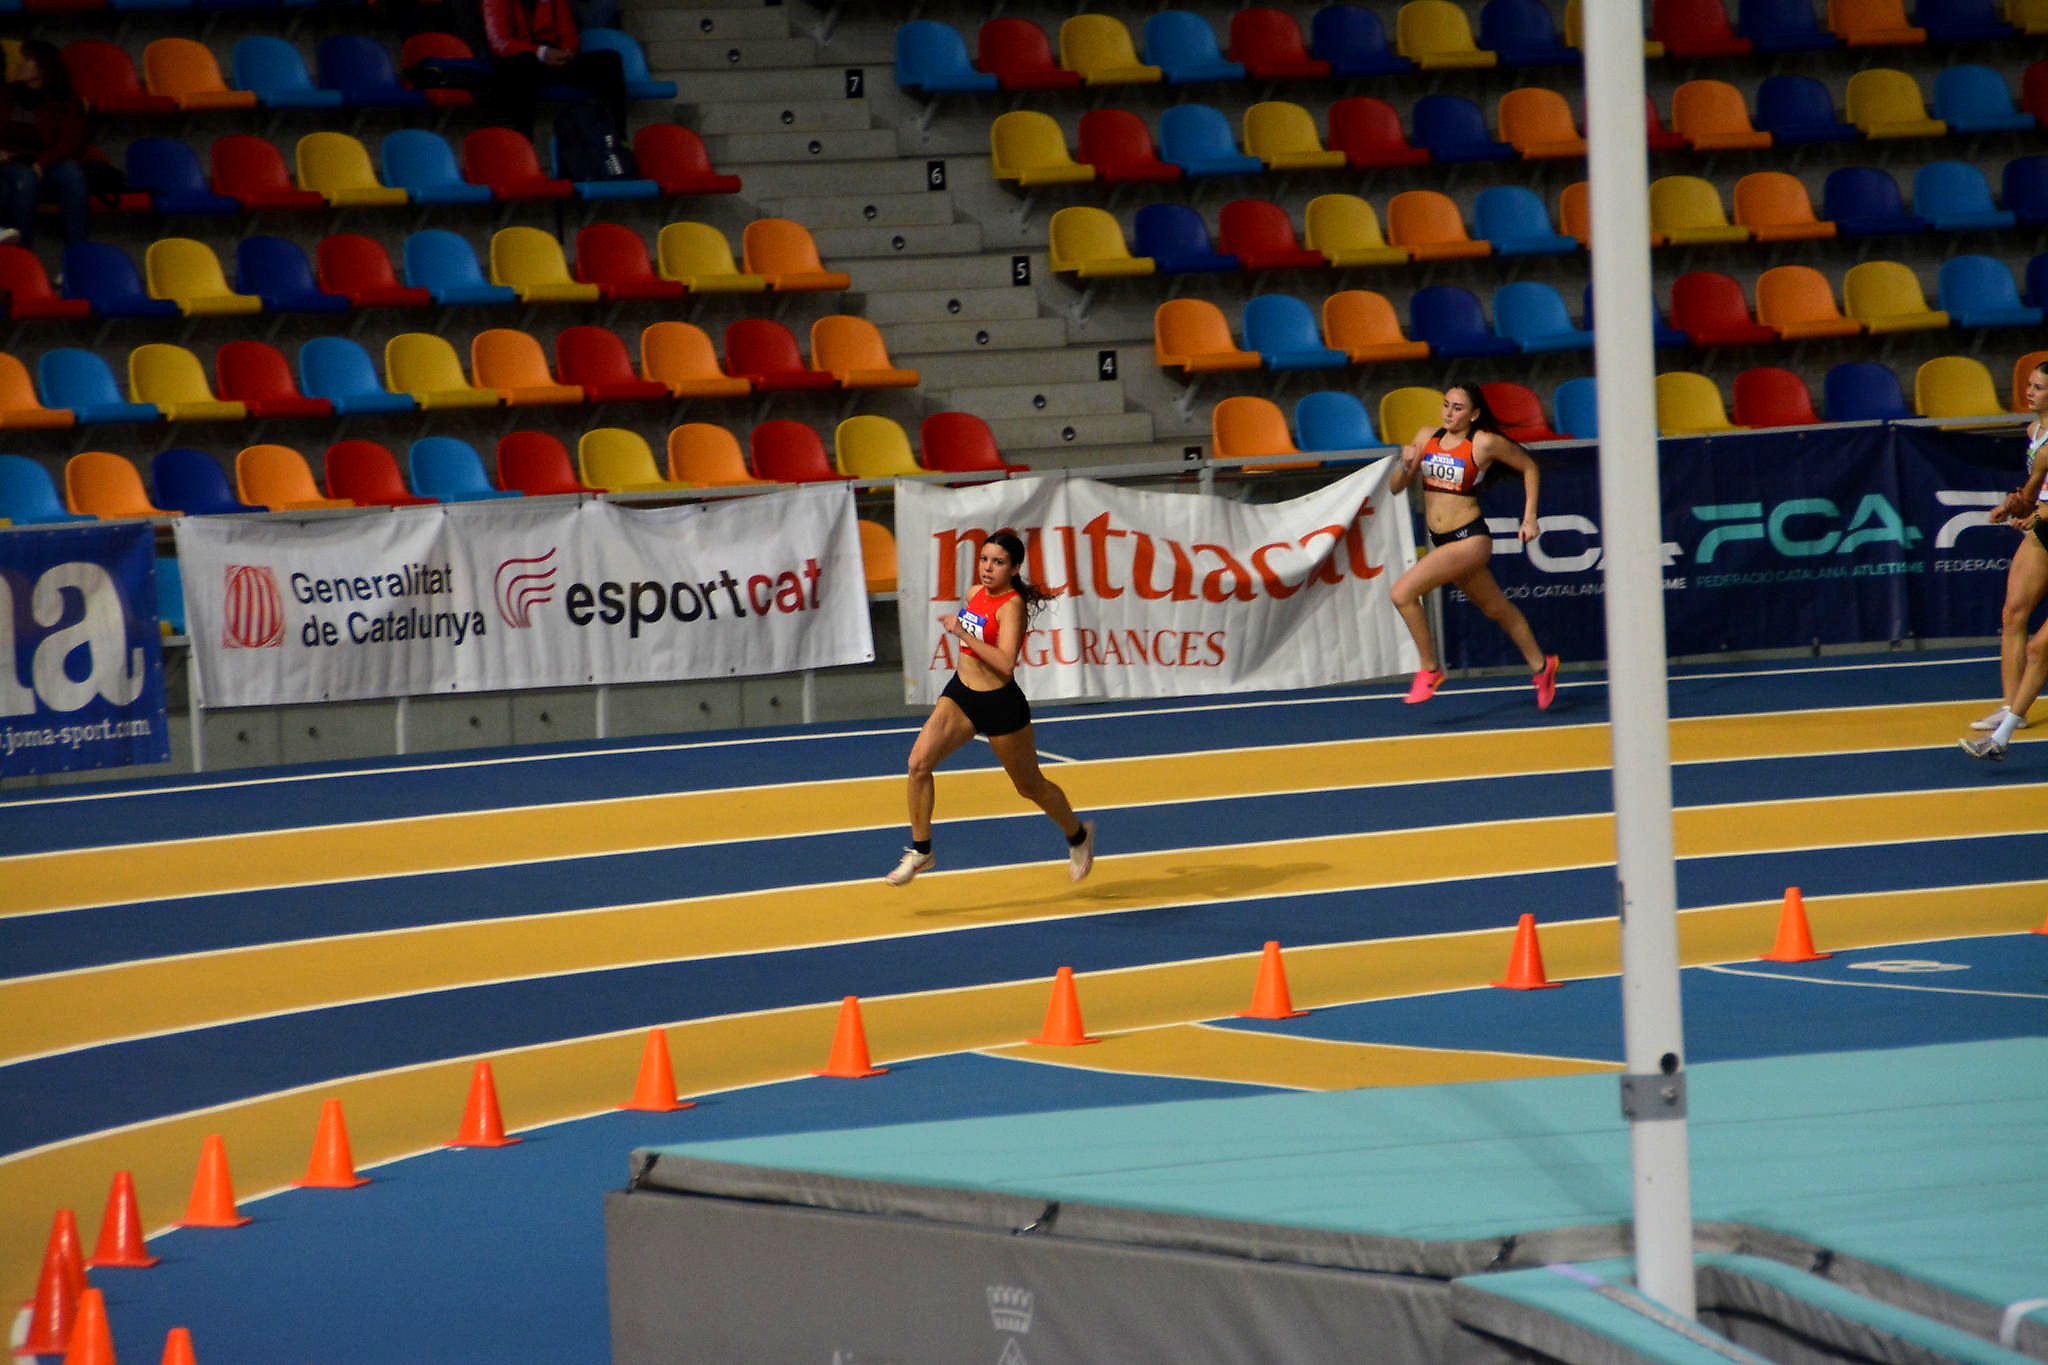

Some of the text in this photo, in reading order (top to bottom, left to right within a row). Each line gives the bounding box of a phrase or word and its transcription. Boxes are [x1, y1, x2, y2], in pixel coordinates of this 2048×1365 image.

[849, 76, 860, 93] 7
[931, 167, 943, 183] 6
[1016, 262, 1028, 278] 5
[1102, 357, 1114, 373] 4
[1430, 464, 1455, 481] 109
[1691, 493, 1924, 564] FCA
[931, 495, 1384, 602] mutuacat
[1934, 558, 2013, 573] FEDERAC
[290, 563, 453, 604] Generalitat
[566, 558, 822, 638] esportcat
[302, 605, 487, 648] de Catalunya
[929, 628, 1226, 671] AGURANCES
